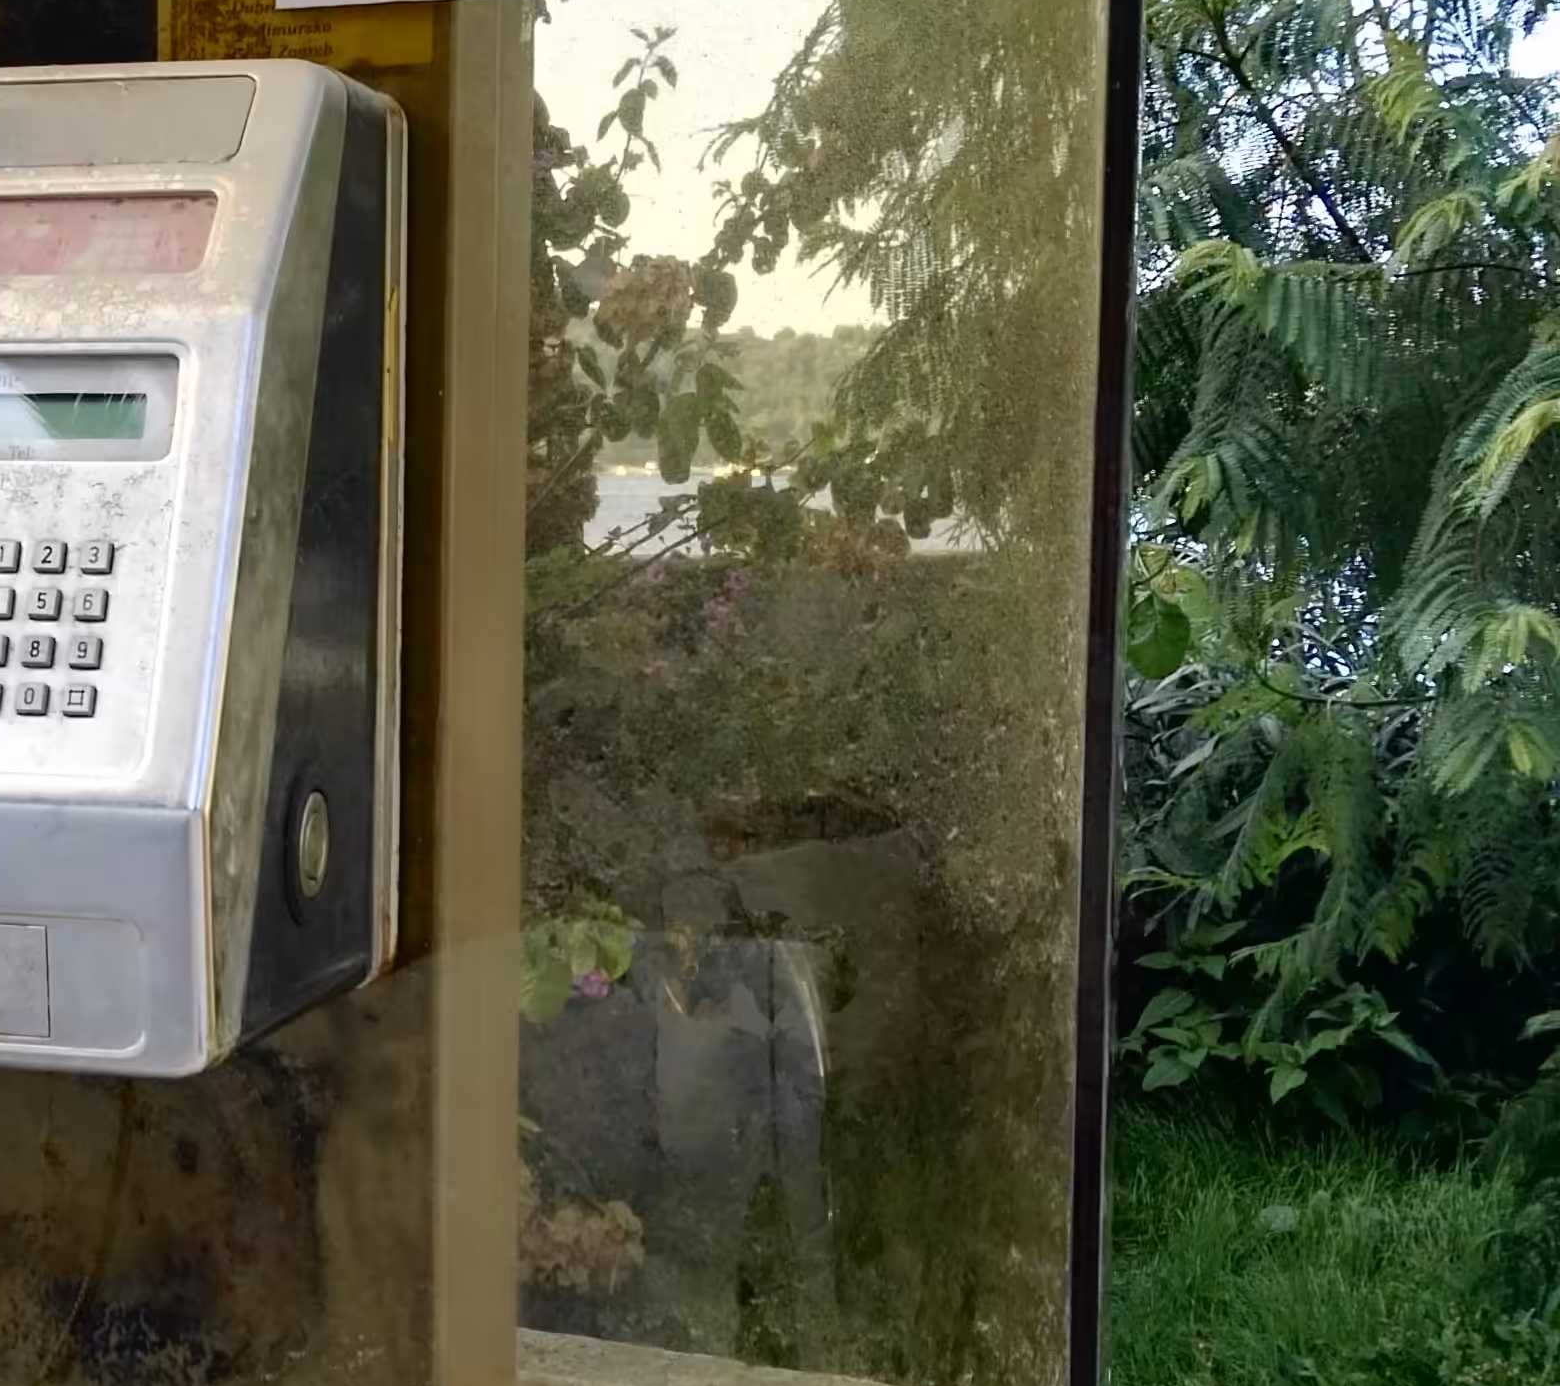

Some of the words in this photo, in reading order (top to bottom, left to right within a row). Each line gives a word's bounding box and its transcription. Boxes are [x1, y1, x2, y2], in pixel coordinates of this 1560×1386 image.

[0, 545, 5, 562] 1
[41, 546, 53, 565] 2
[88, 546, 99, 564] 3
[36, 592, 48, 610] 5
[83, 594, 93, 611] 6
[29, 640, 41, 658] 8
[77, 642, 88, 659] 9
[24, 688, 35, 704] 0
